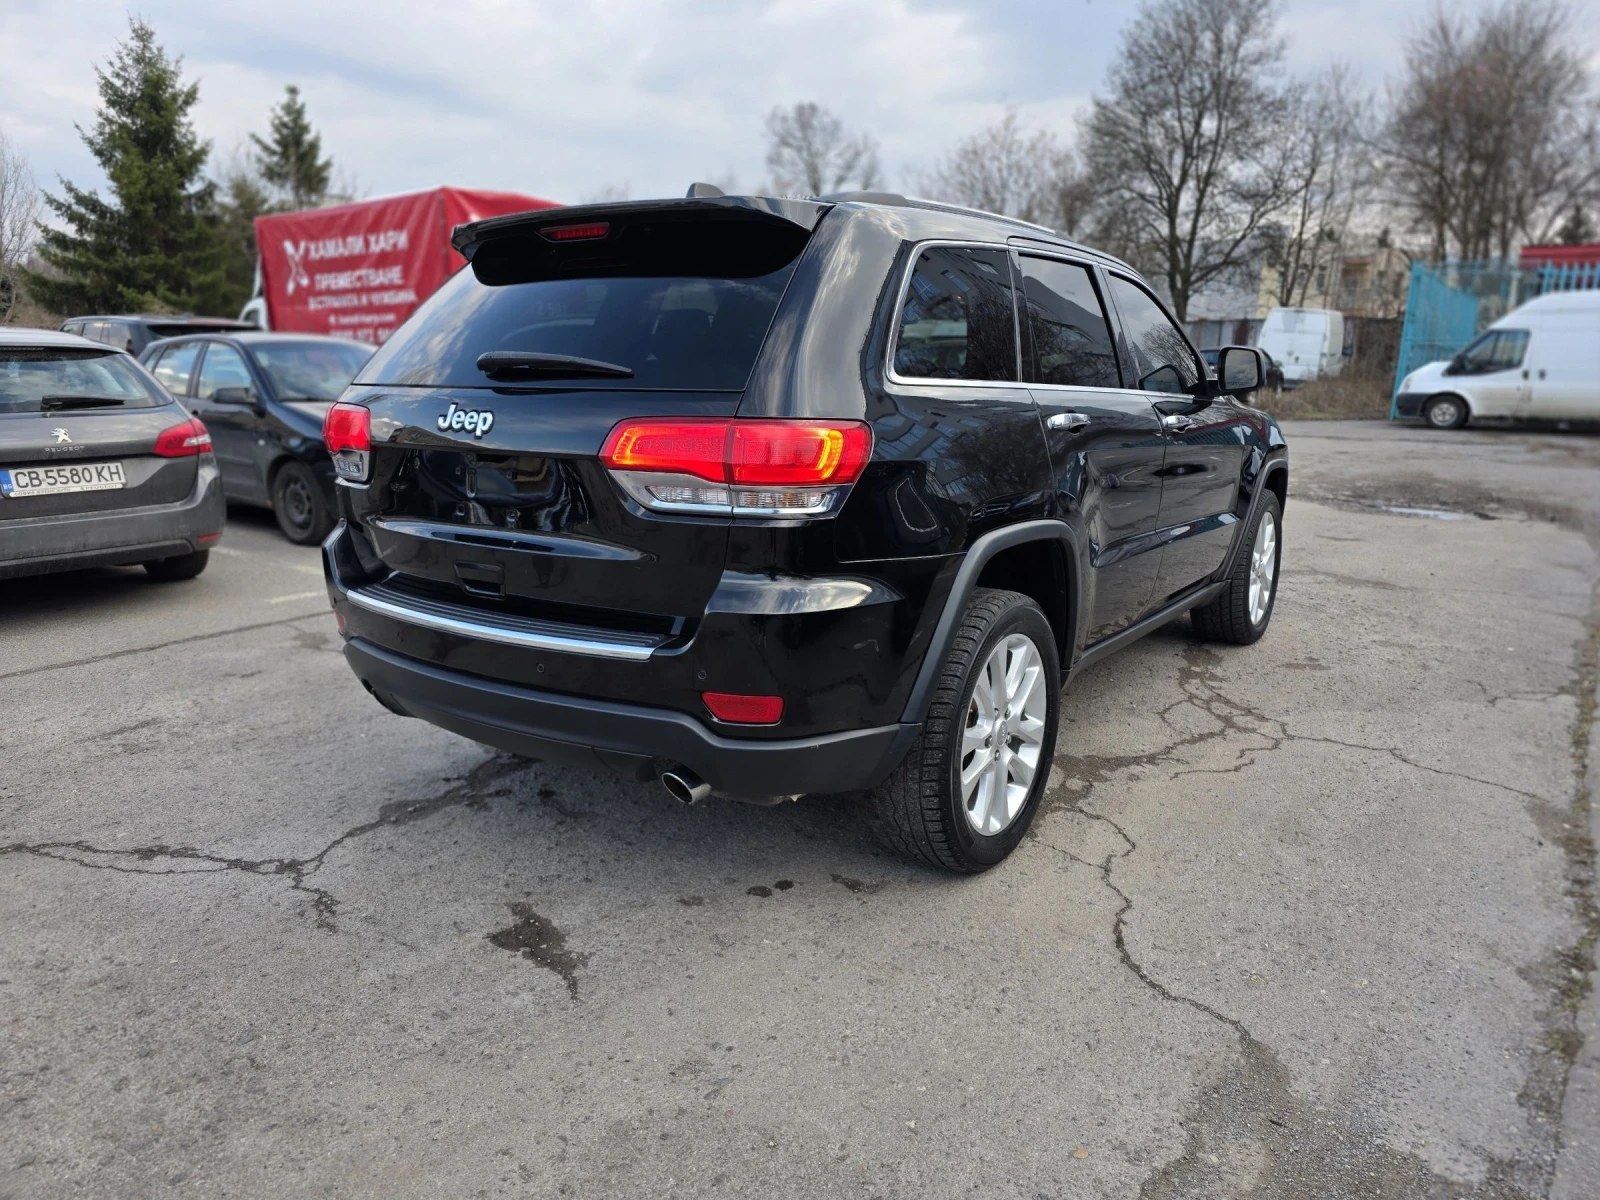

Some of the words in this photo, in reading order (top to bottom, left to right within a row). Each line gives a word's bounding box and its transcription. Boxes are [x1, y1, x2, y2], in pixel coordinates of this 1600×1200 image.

[308, 235, 365, 259] ХАМАЛИ
[367, 230, 408, 253] ХАРИ
[314, 265, 404, 290] ПРЕМЕСТВАНЕ
[437, 403, 494, 438] Jeep
[3, 483, 13, 491] BG
